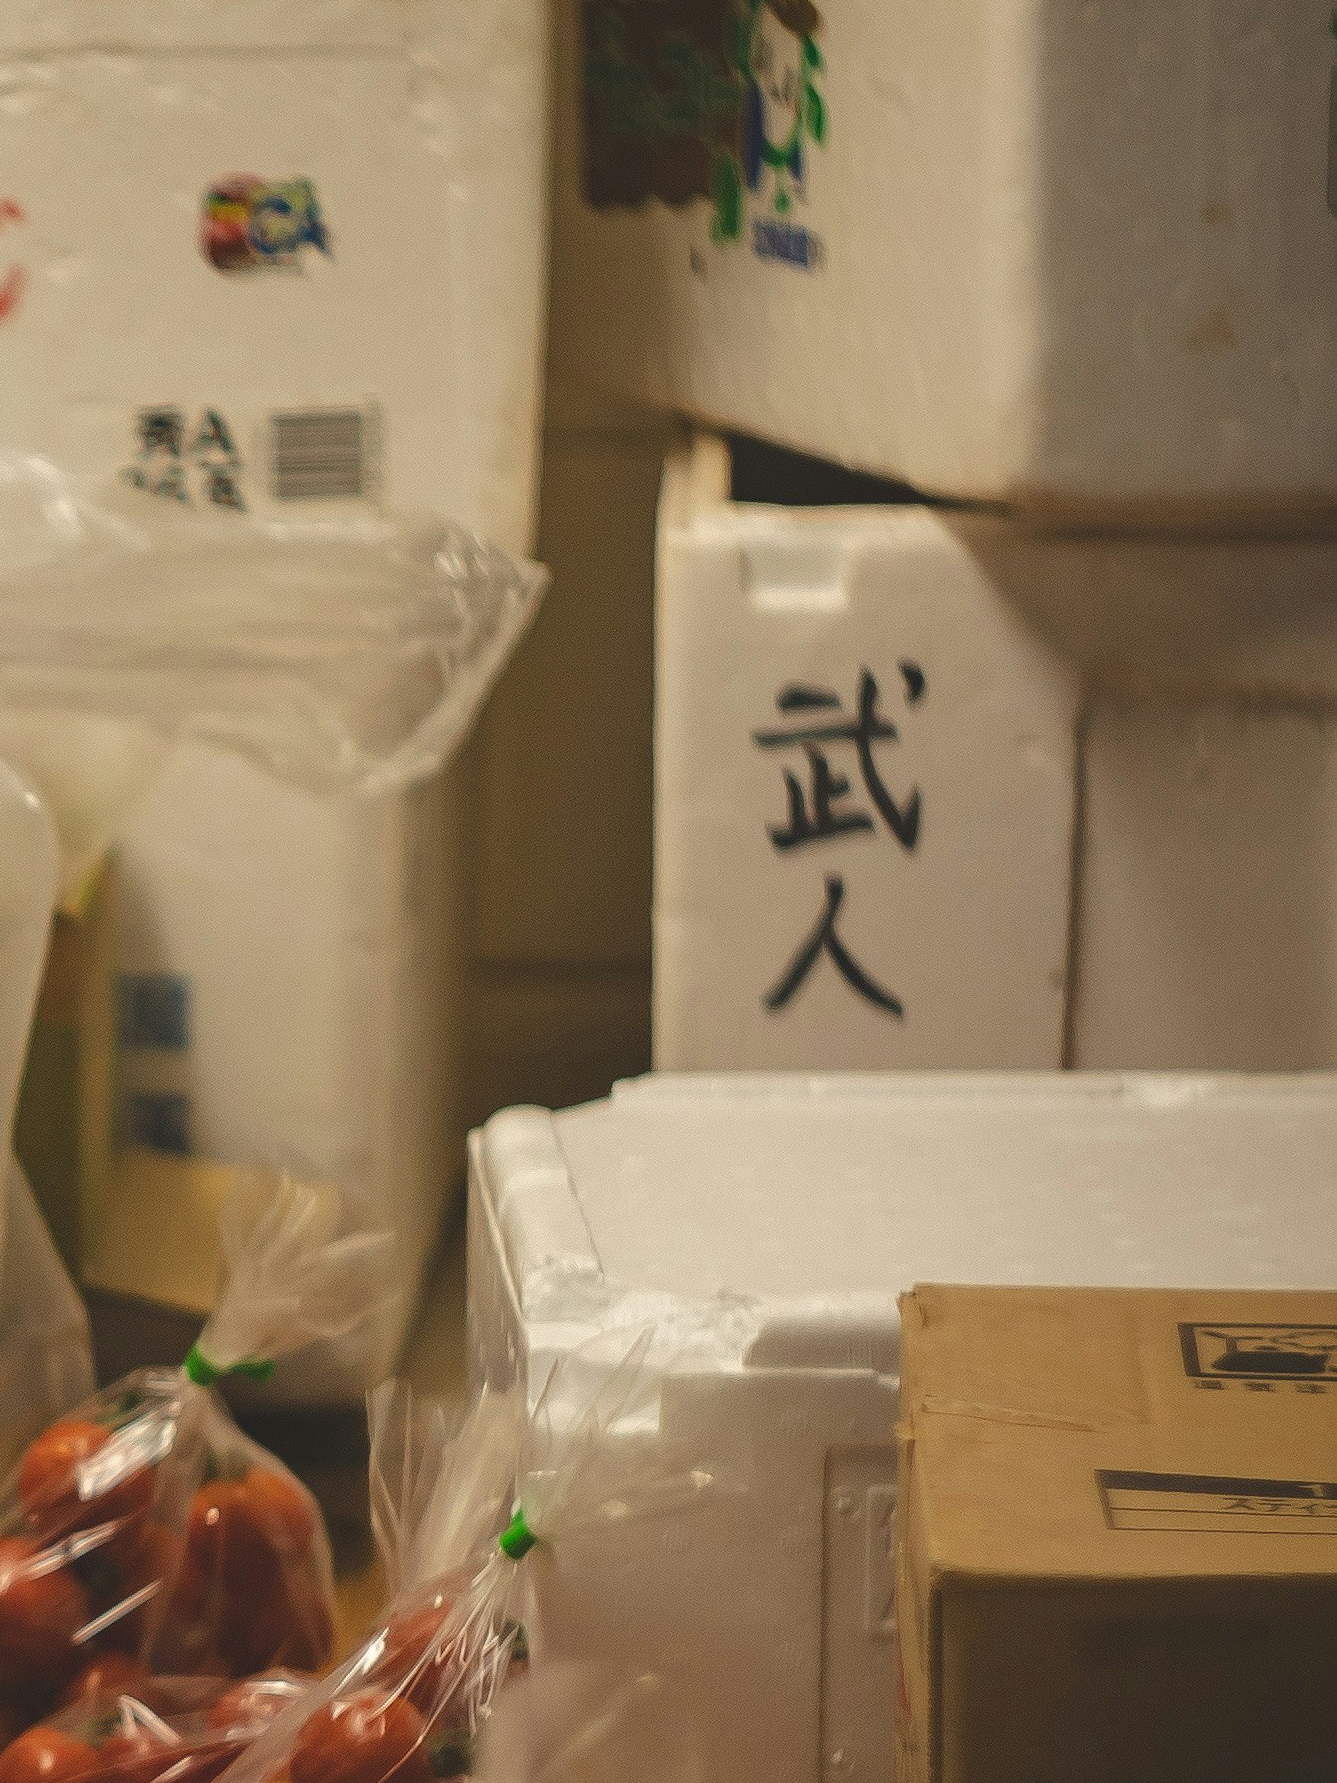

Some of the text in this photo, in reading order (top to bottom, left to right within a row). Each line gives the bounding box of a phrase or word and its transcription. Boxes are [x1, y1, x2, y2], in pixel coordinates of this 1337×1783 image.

[754, 660, 929, 1020] 武人
[1222, 1498, 1337, 1515] ステイ
